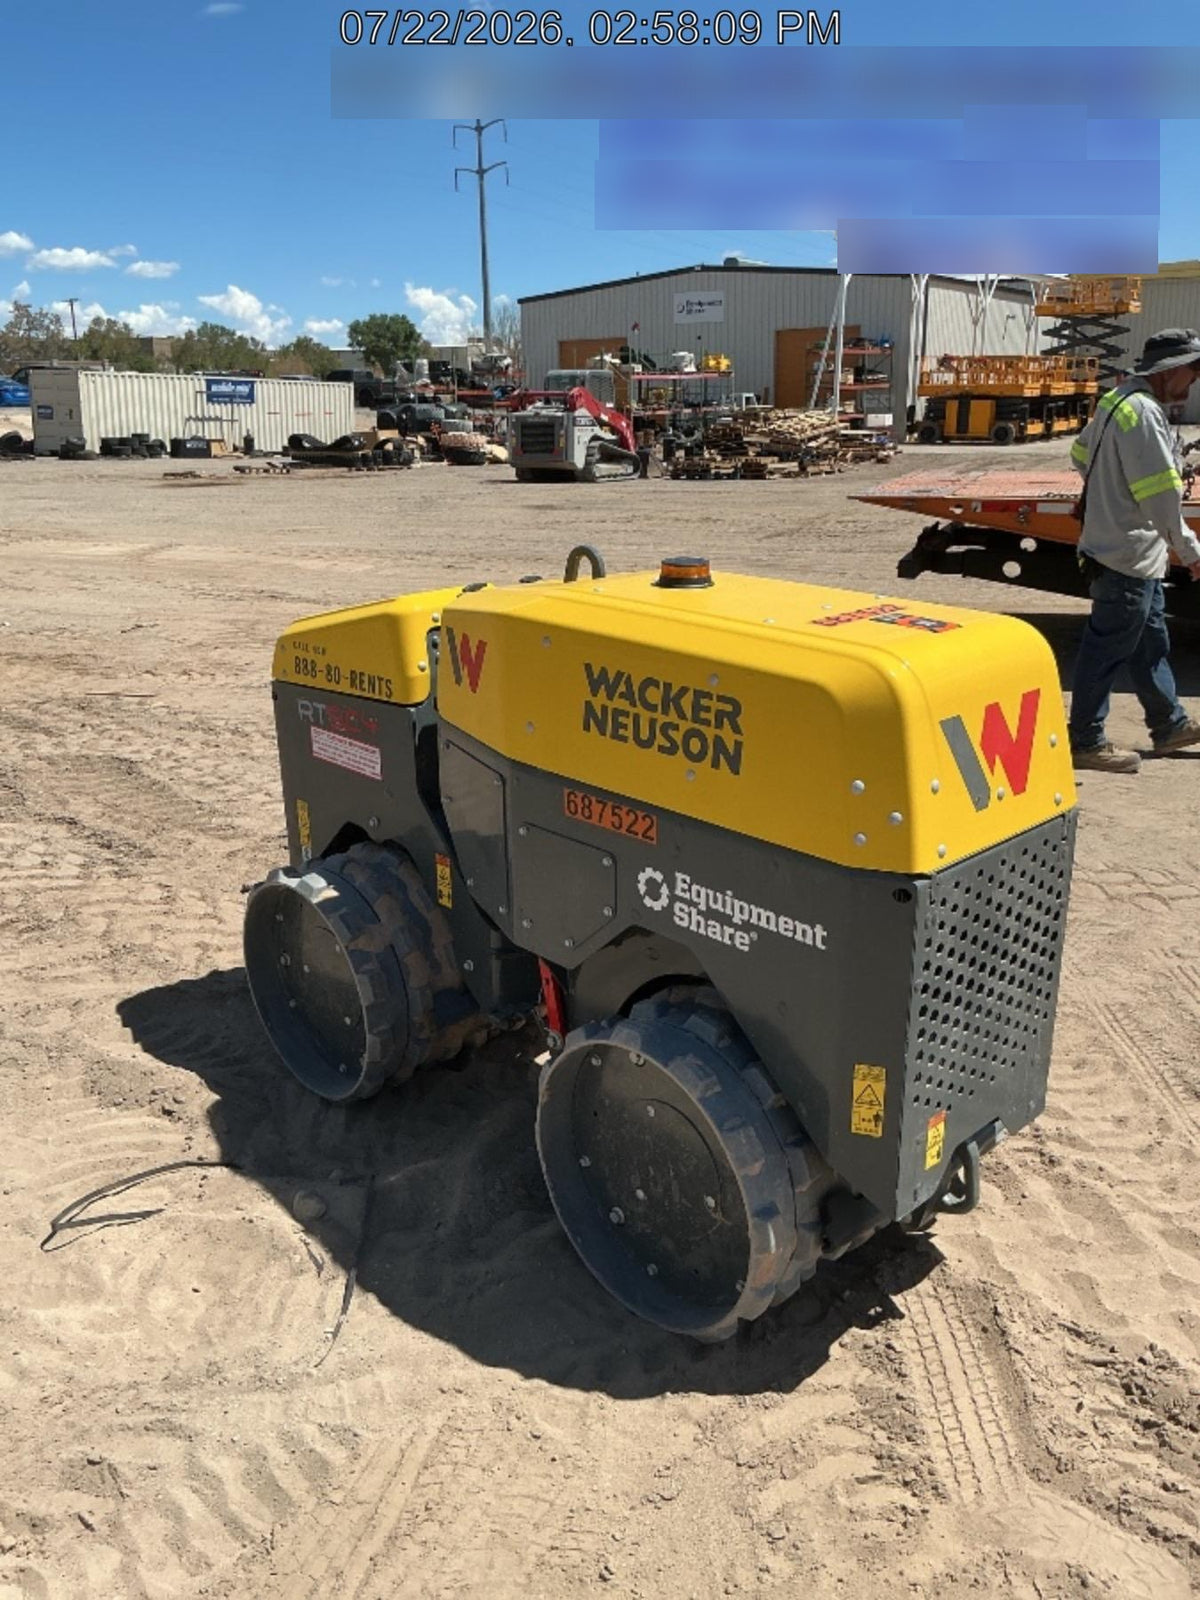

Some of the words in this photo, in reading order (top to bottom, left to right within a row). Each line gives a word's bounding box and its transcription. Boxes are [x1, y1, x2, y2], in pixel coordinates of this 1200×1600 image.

[582, 699, 744, 776] NEUSON
[583, 662, 744, 737] WACKER
[565, 790, 656, 843] 687522
[674, 871, 828, 951] Equipment
